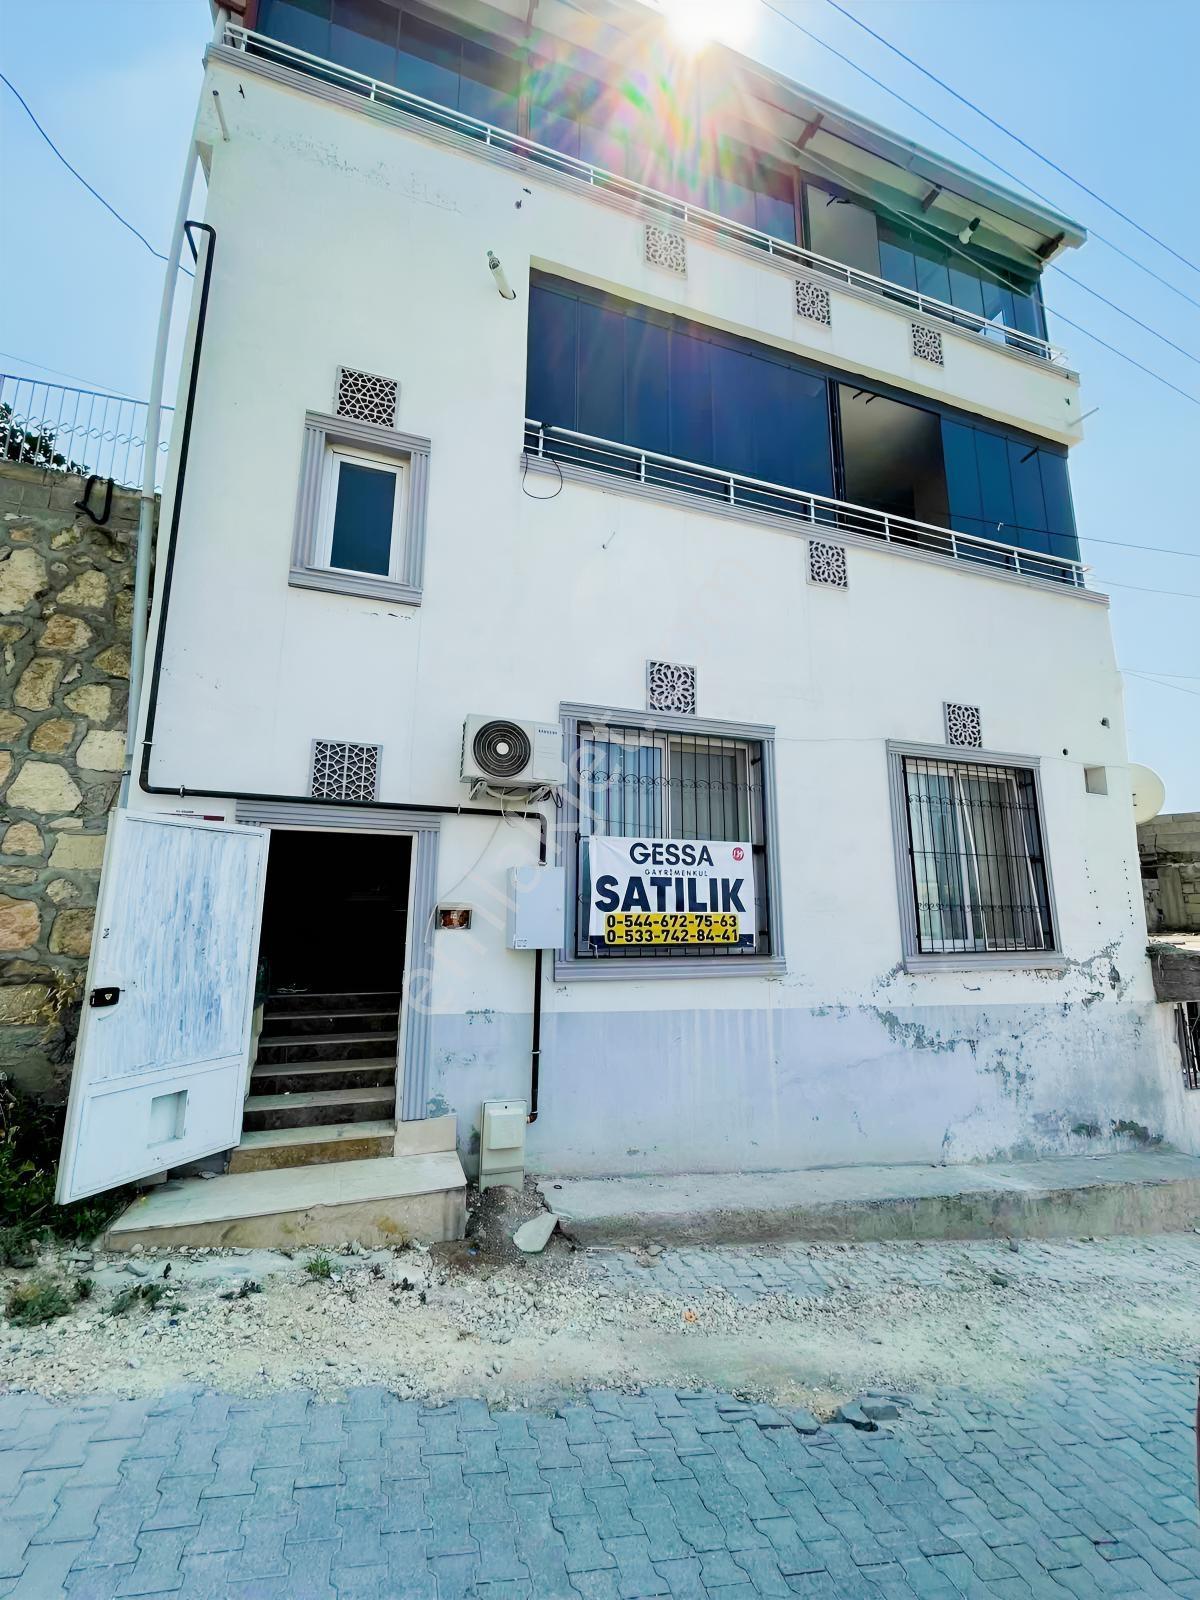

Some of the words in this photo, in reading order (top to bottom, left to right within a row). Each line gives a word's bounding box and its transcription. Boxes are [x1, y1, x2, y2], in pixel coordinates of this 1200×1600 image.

[629, 842, 714, 867] GESSA
[594, 875, 746, 913] SATILIK
[606, 914, 737, 928] 0-544-672-75-63
[606, 929, 738, 943] 0-533-742-84-41
